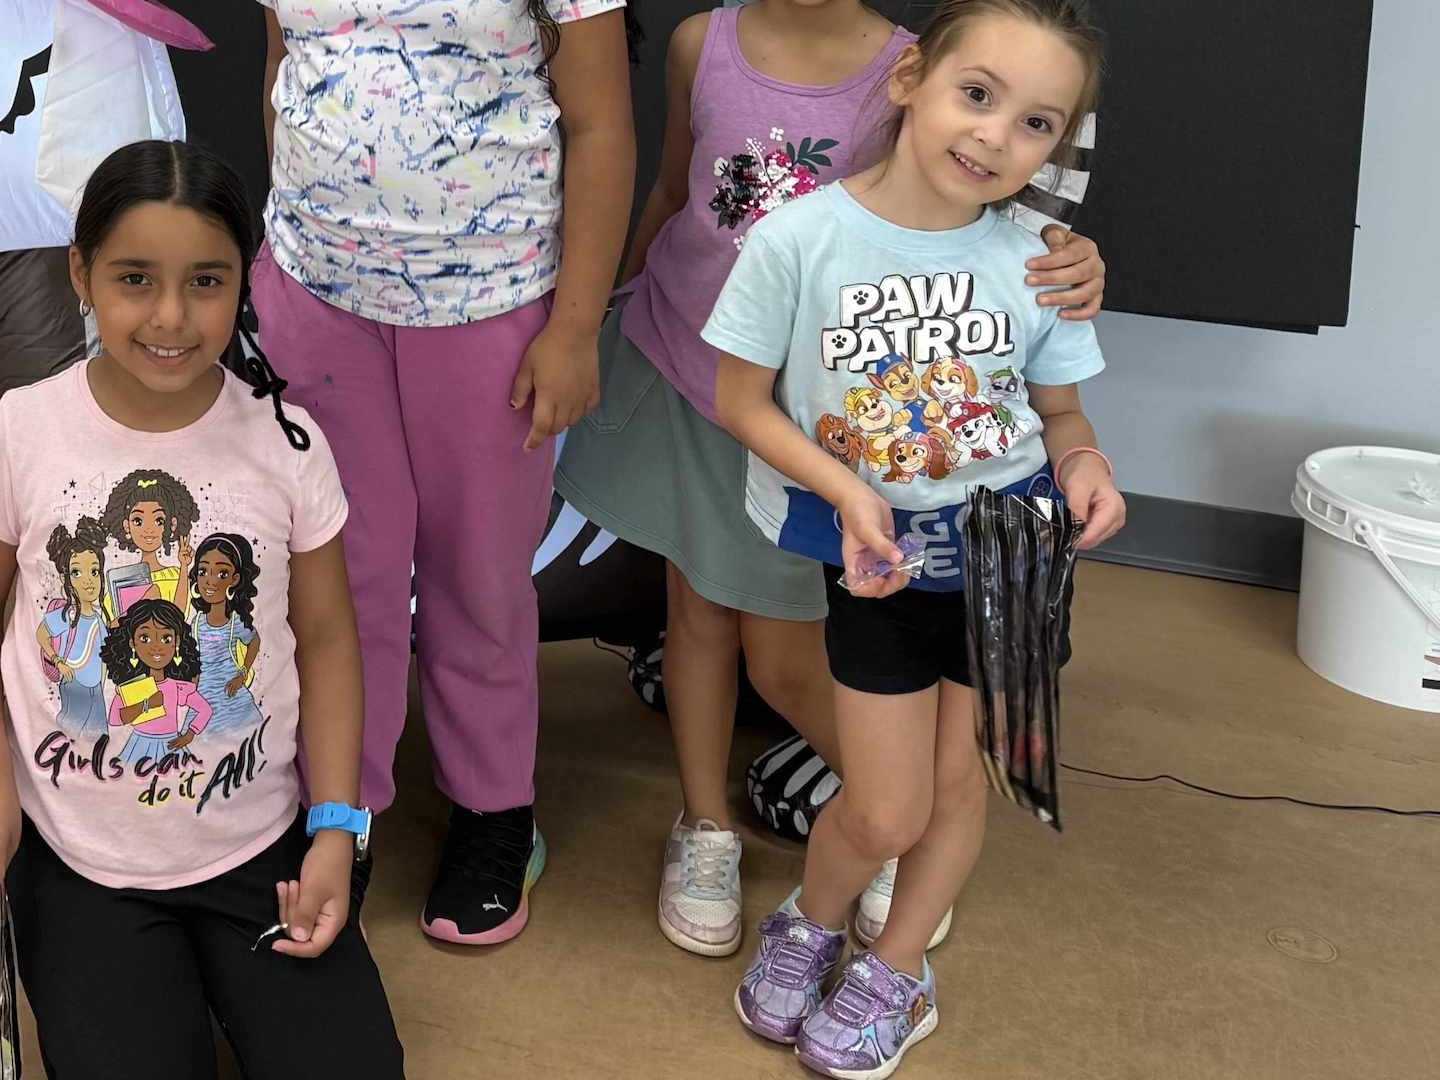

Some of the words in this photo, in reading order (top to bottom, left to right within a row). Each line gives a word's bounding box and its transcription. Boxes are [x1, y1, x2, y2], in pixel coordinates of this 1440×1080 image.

[839, 271, 974, 327] PAW
[821, 308, 1015, 372] PATROL
[34, 730, 124, 789] Girls
[134, 750, 203, 777] can
[138, 775, 170, 806] do
[179, 770, 205, 799] it
[195, 716, 272, 814] All!
